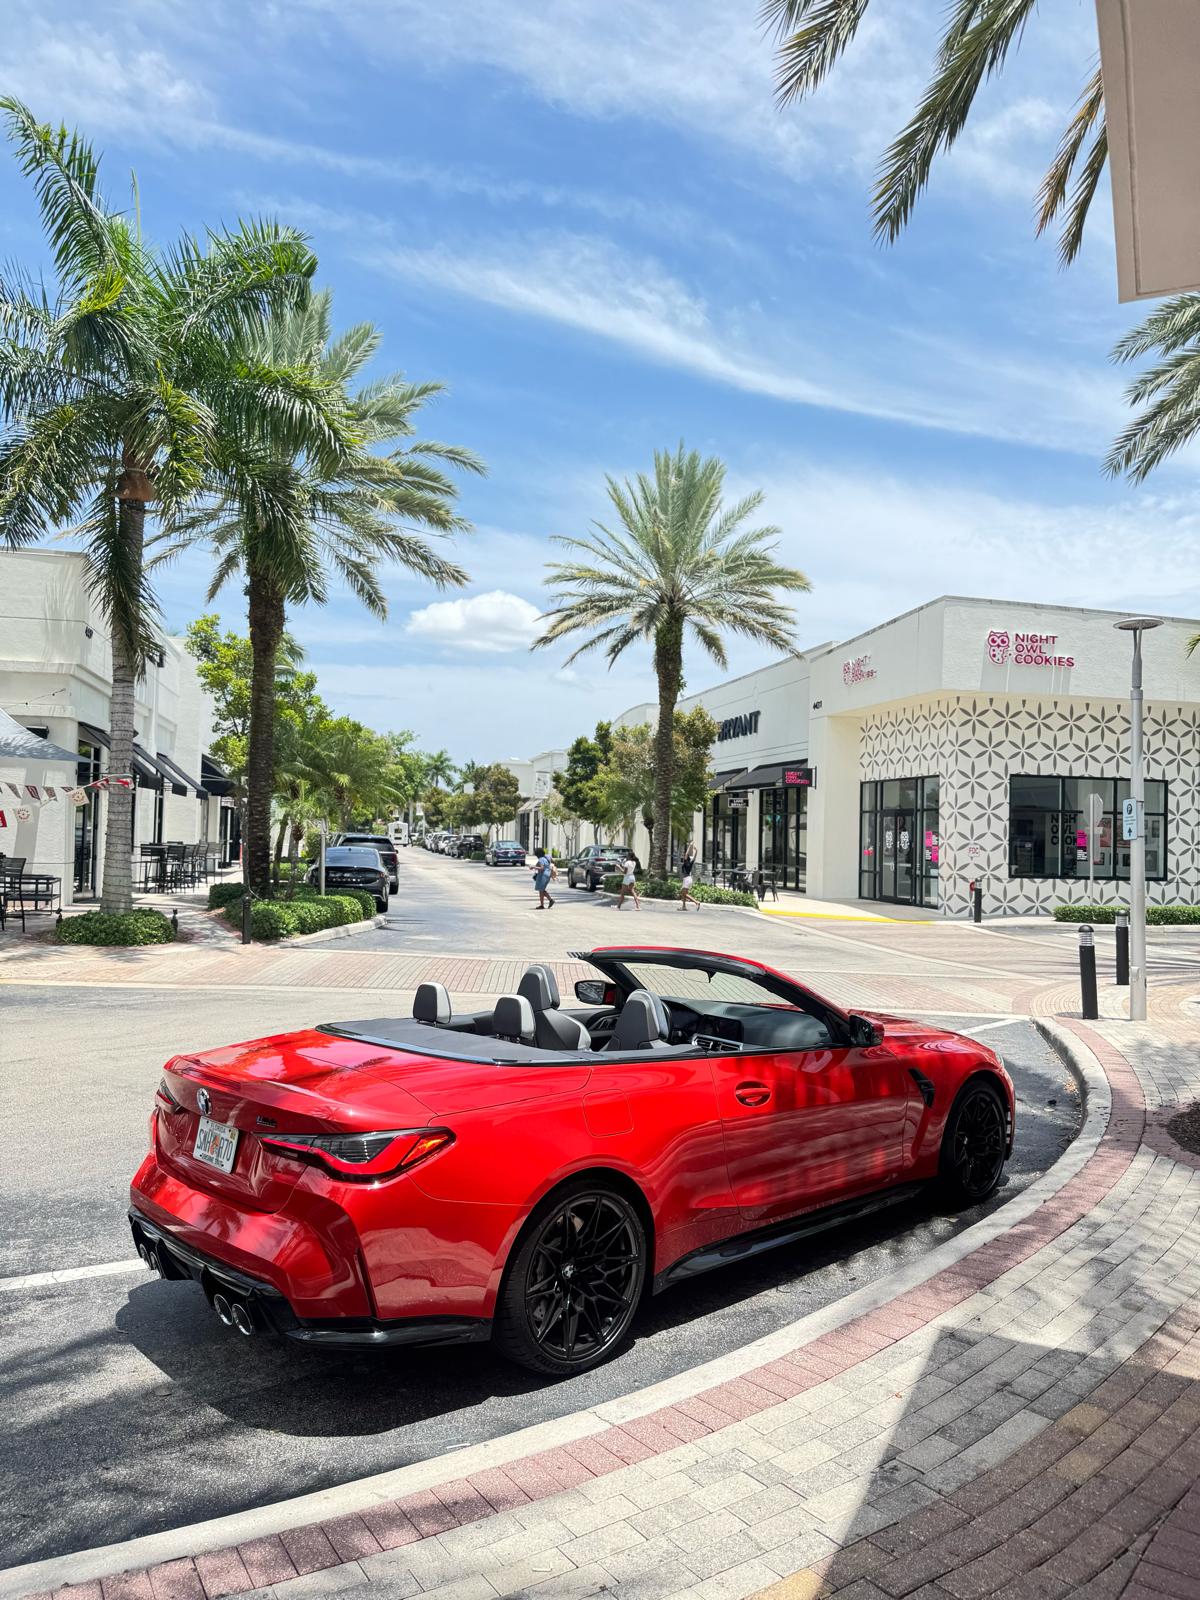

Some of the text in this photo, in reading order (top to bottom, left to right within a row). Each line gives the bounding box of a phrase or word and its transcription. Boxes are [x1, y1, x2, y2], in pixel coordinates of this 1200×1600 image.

[1015, 633, 1058, 644] NIGHT
[1015, 643, 1046, 654] OWL
[1014, 654, 1075, 667] COOKIES
